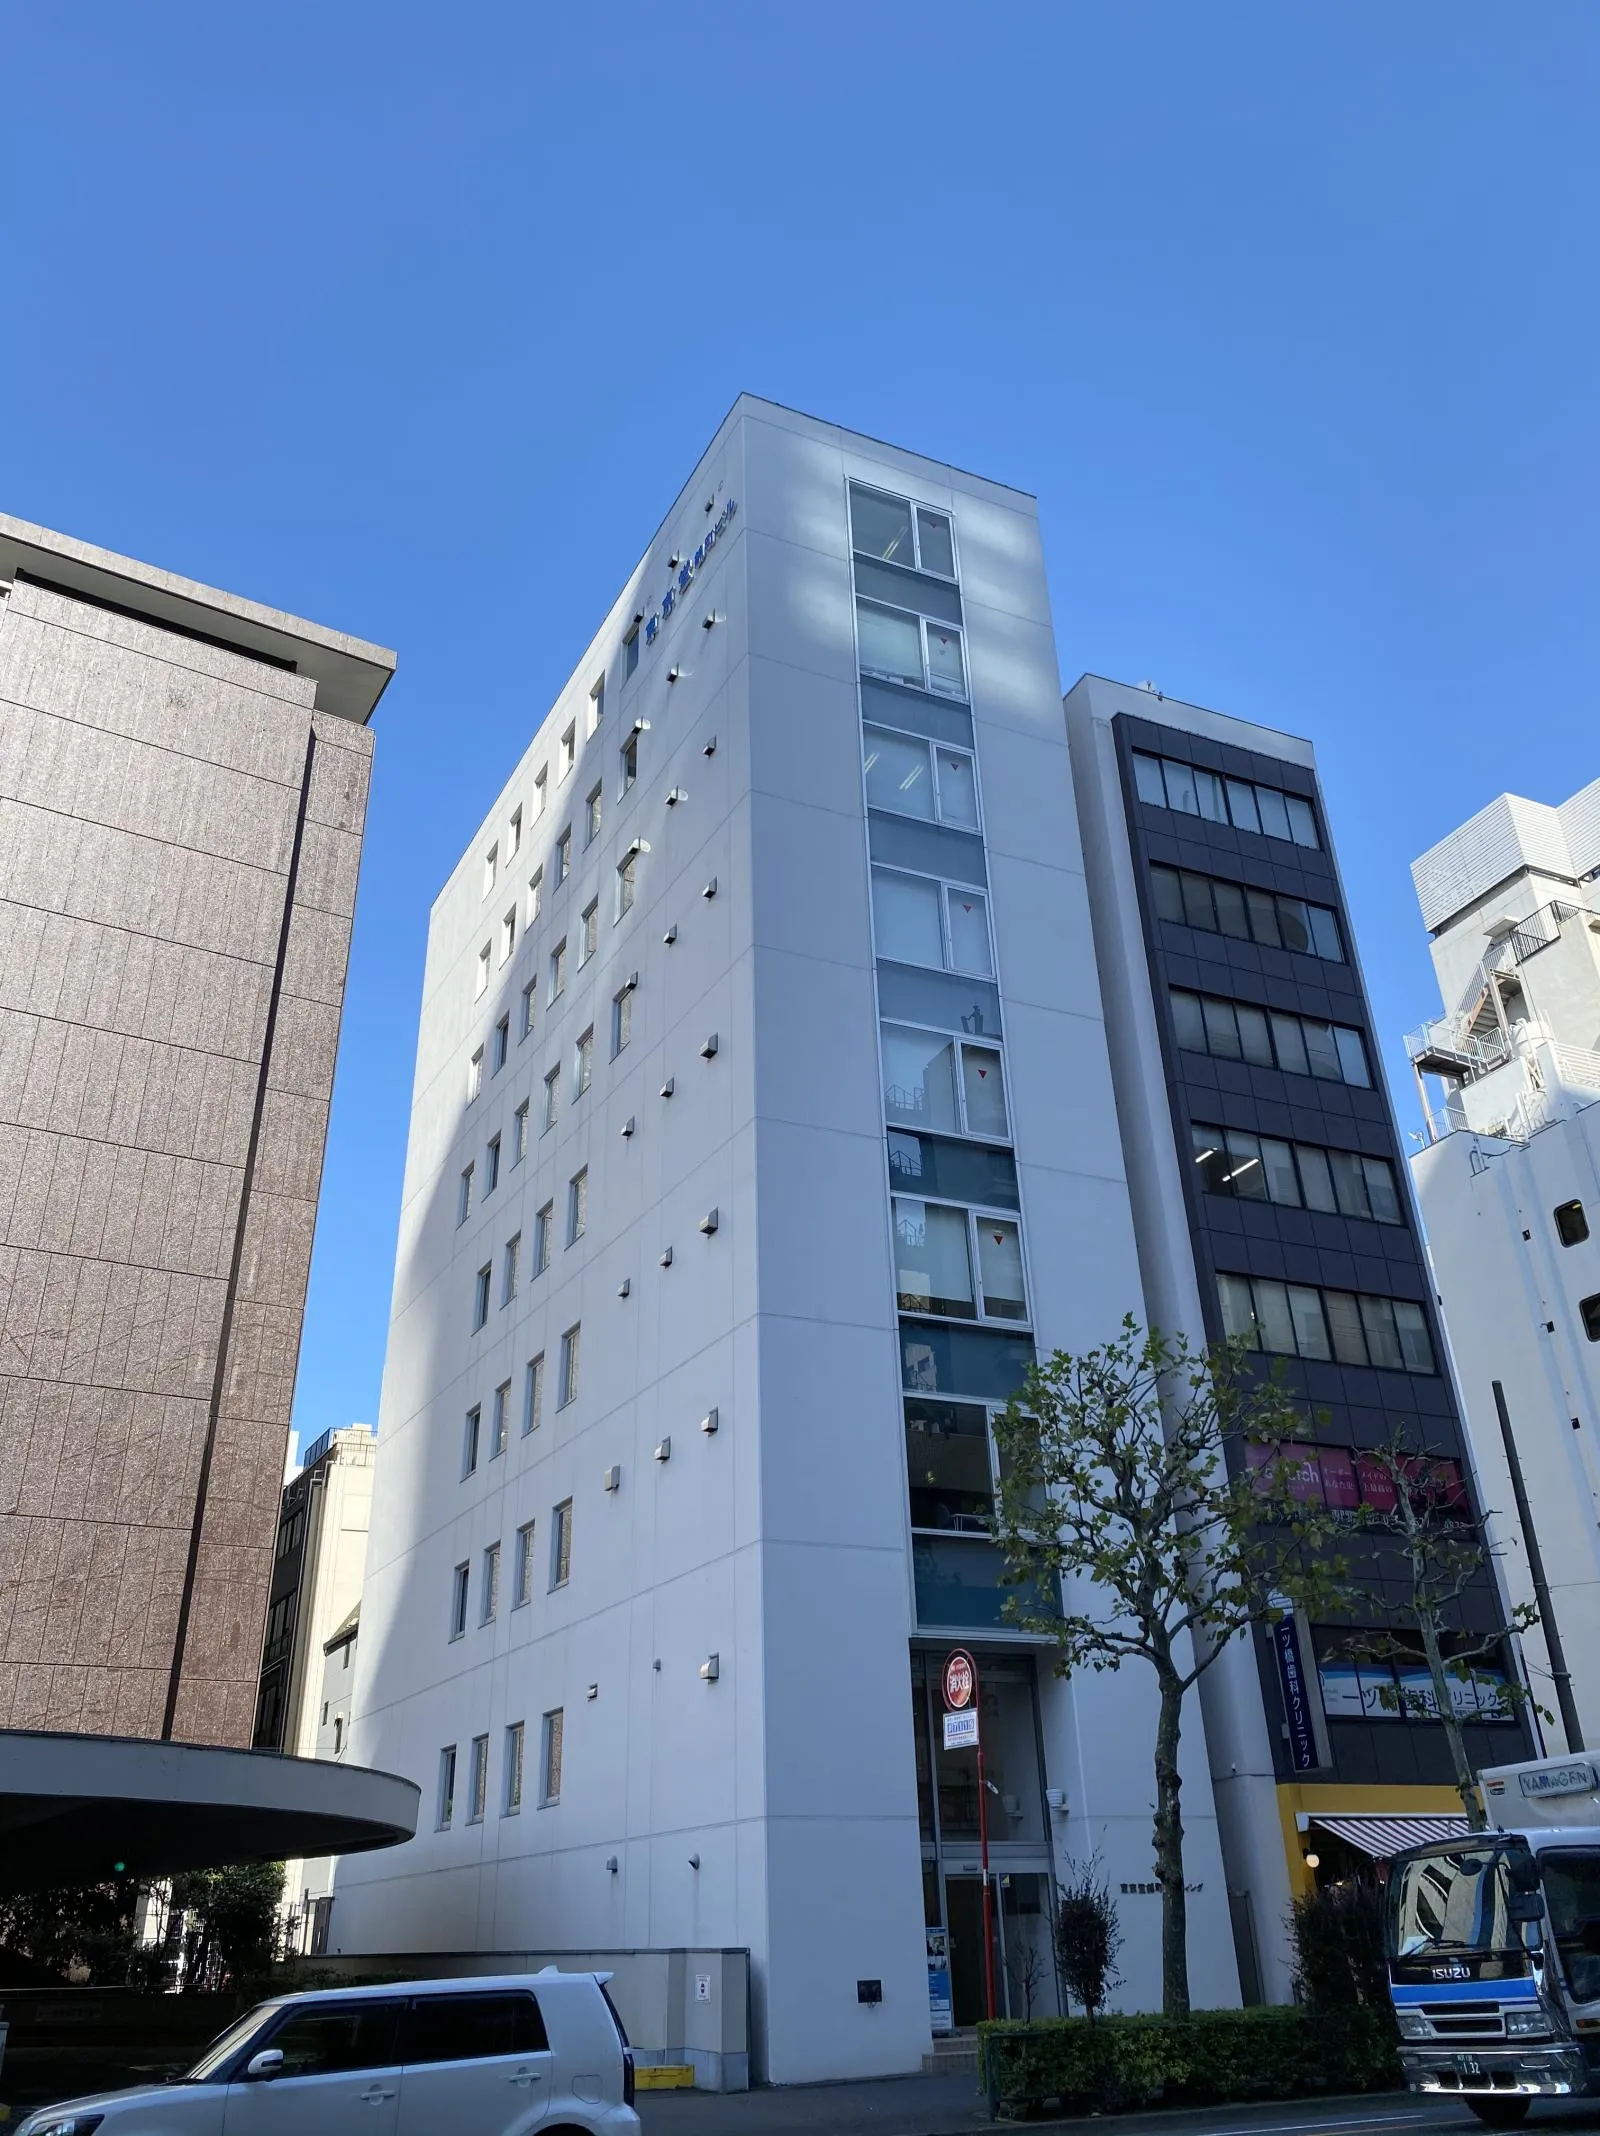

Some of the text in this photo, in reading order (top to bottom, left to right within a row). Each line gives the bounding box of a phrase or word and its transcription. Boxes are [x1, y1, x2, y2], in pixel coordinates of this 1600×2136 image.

[949, 1670, 970, 1694] 消火栓
[1280, 1627, 1311, 1768] 一ツ橋歯科クリニック
[1341, 1687, 1498, 1711] 一ツ歯科リニック
[1432, 1967, 1471, 1979] ISUZU
